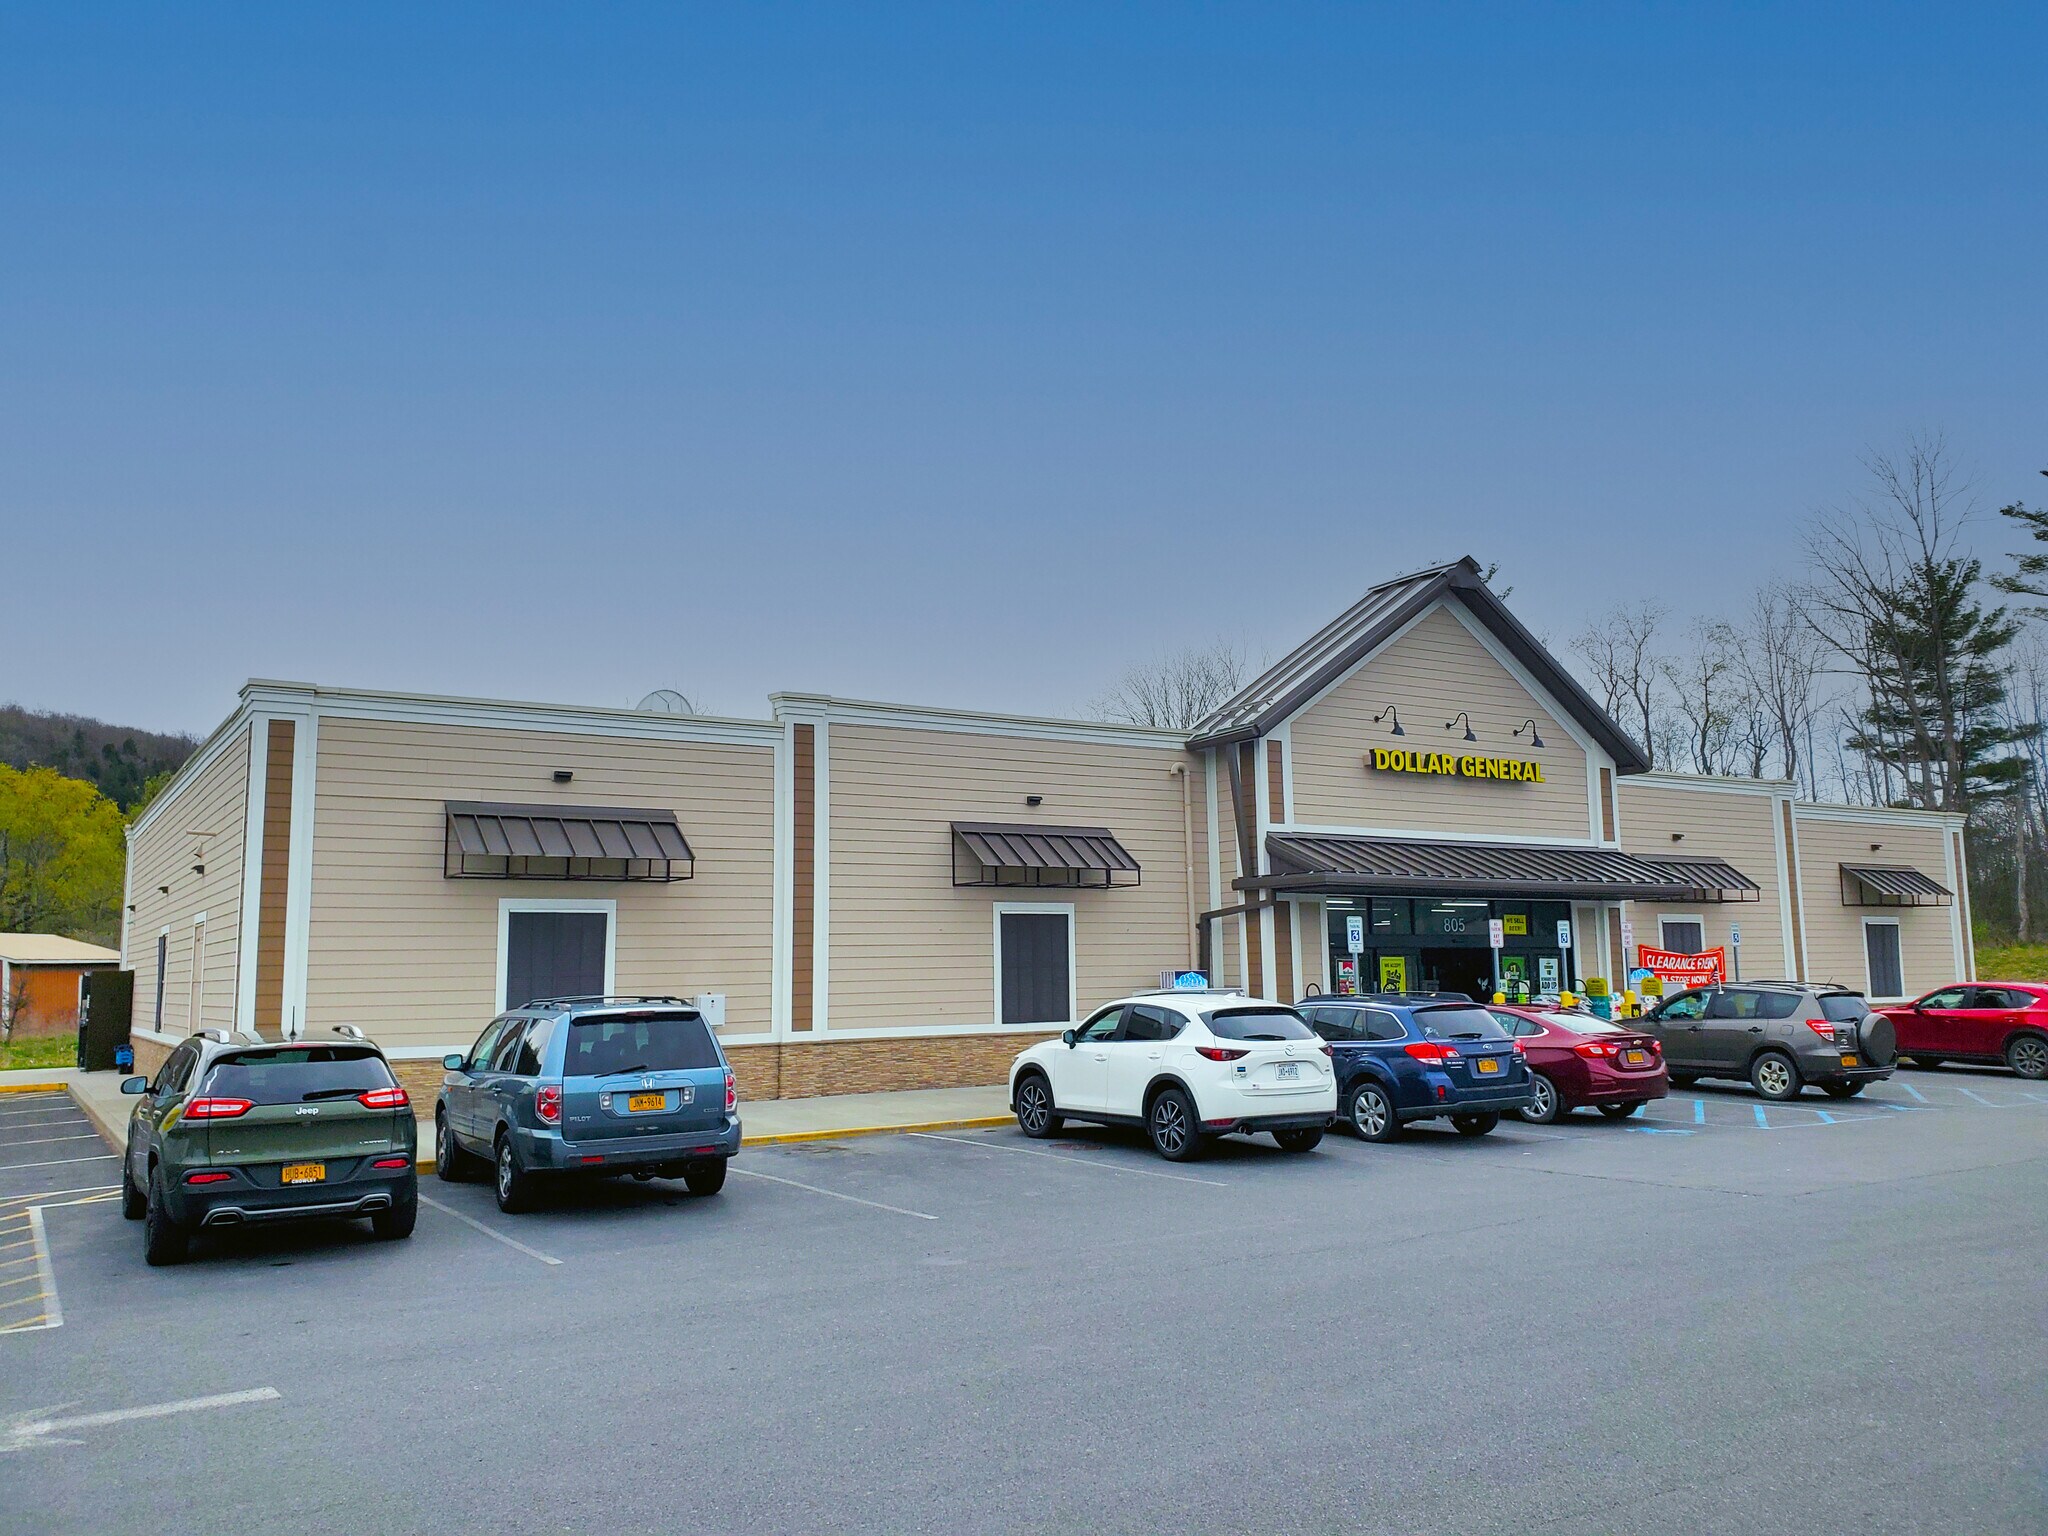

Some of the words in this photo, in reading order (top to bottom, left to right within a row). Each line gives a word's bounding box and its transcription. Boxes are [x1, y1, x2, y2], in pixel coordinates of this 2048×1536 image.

[1373, 748, 1455, 775] DOLLAR
[1459, 755, 1546, 783] GENERAL
[1443, 917, 1466, 932] 805
[1646, 955, 1696, 970] CLEARANCE
[295, 1106, 319, 1117] Jeep
